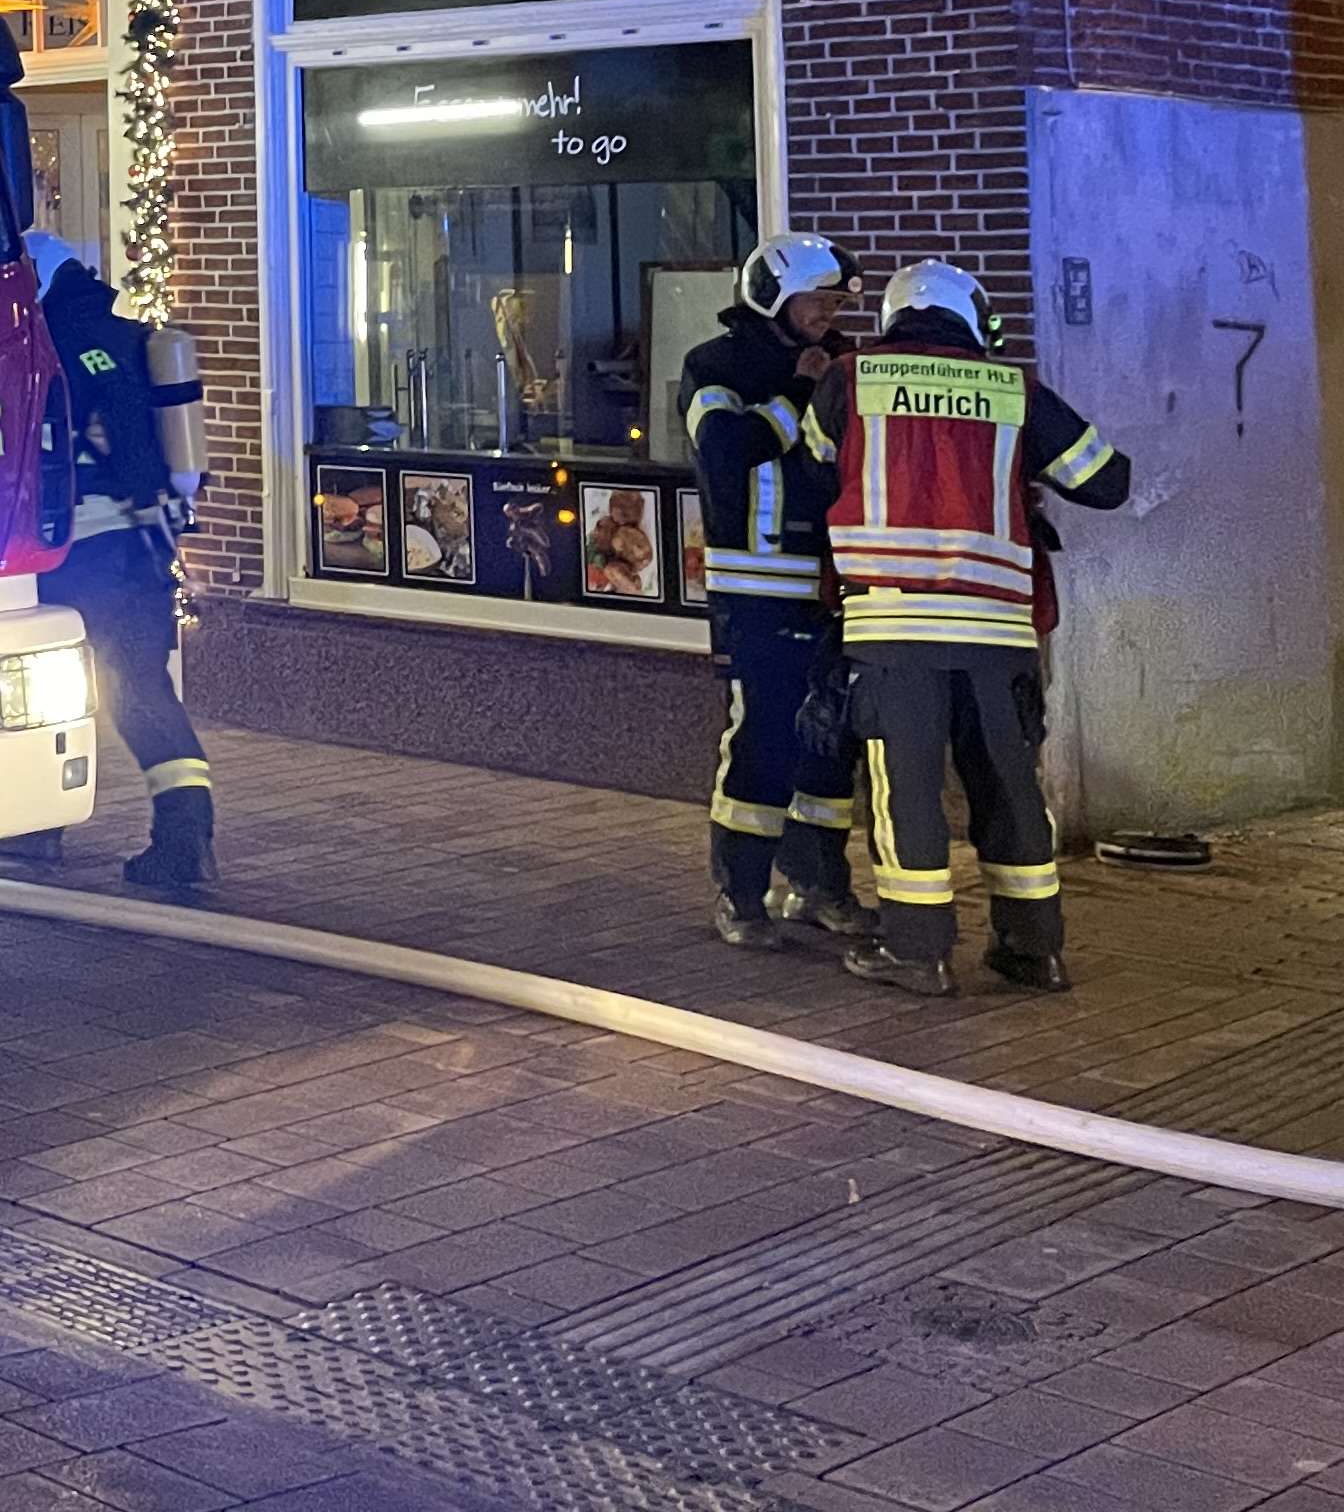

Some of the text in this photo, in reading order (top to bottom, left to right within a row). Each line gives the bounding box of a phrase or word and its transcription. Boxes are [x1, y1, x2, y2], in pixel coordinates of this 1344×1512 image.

[551, 129, 628, 165] to go
[859, 360, 1019, 386] Gruppenführer HLF
[891, 385, 991, 419] Aurich
